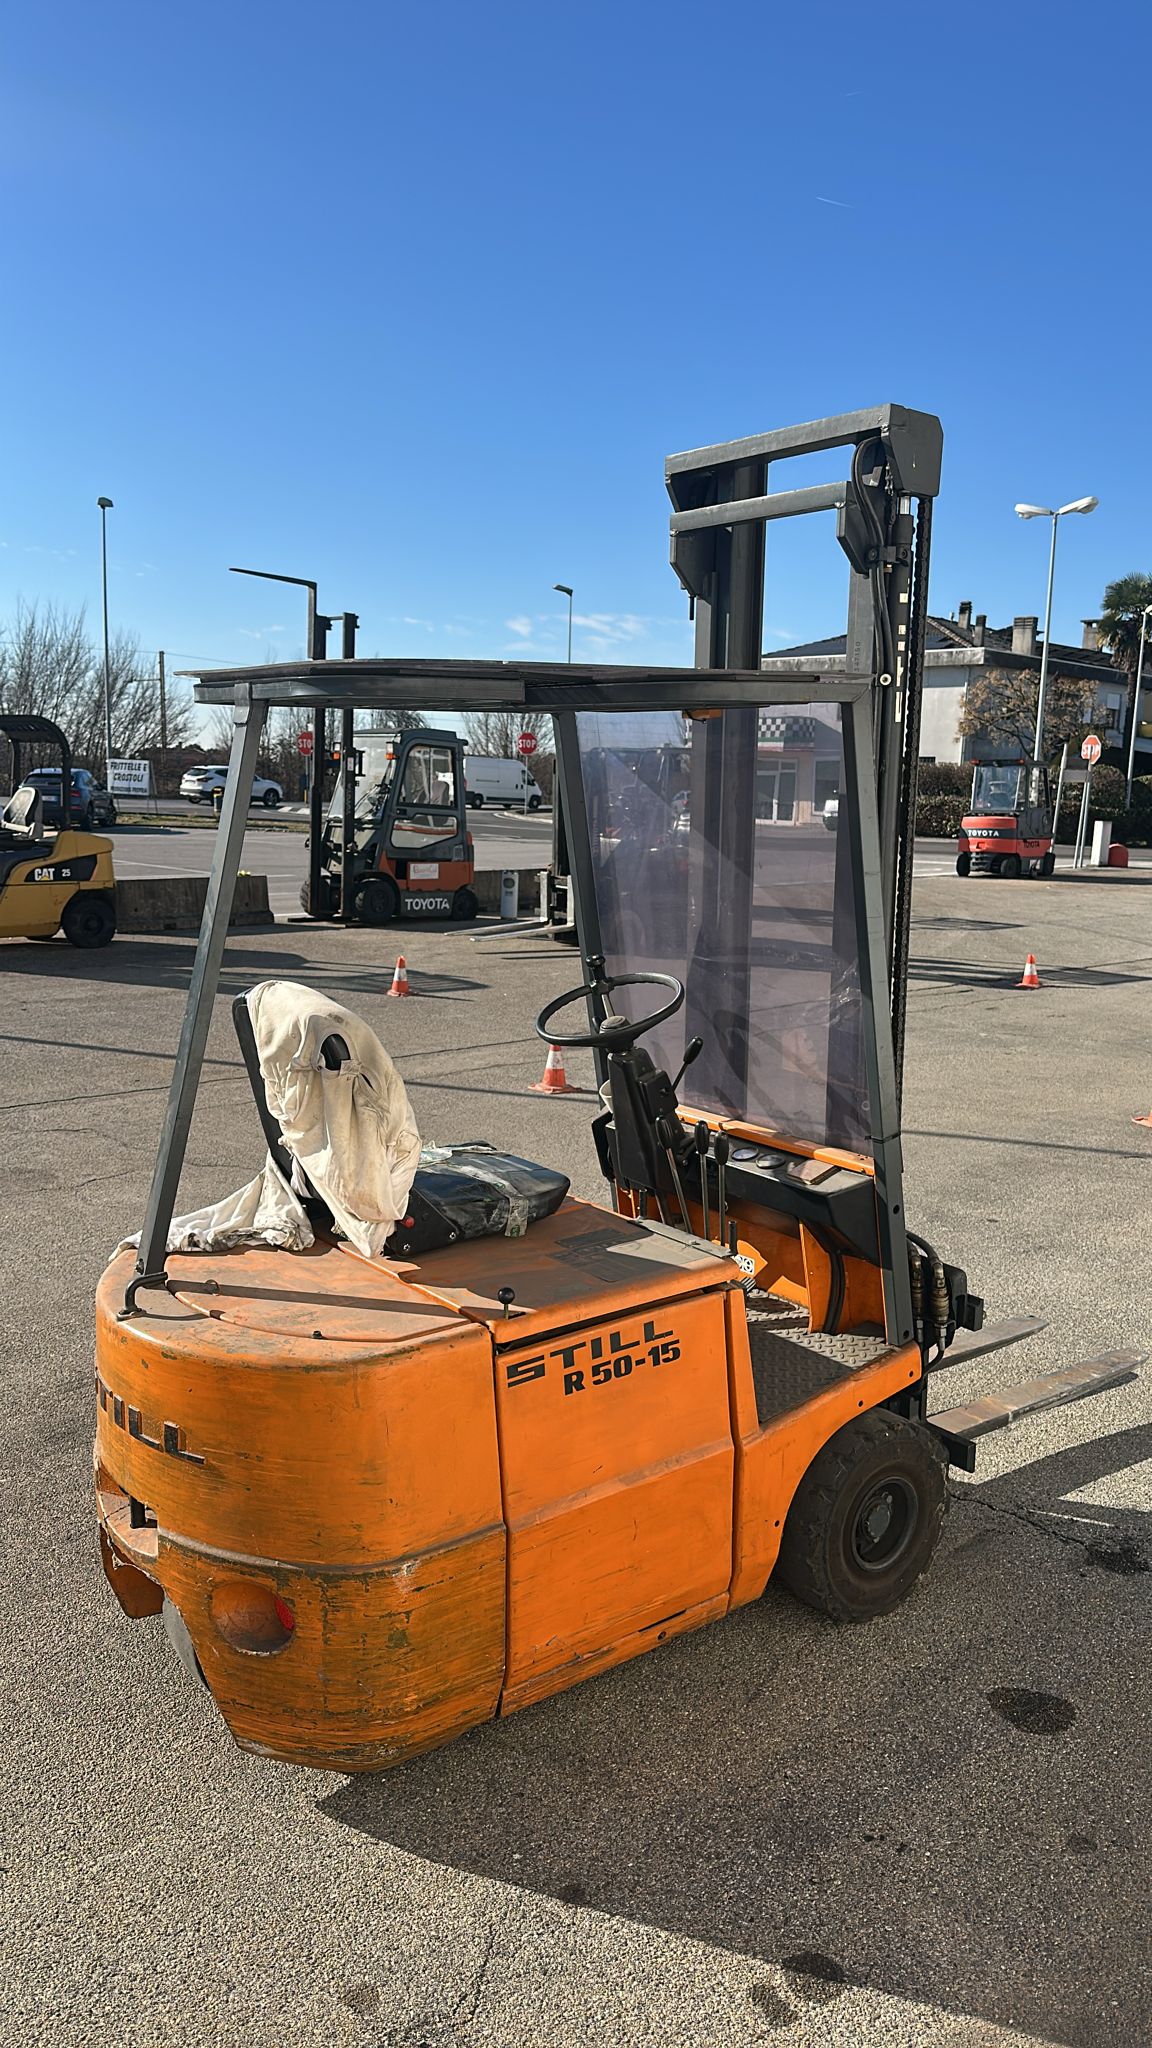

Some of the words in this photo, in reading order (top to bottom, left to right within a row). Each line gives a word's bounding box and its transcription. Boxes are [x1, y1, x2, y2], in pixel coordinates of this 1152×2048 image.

[298, 738, 312, 749] STO
[518, 739, 537, 749] STOP
[110, 761, 142, 771] FRITTELLE
[143, 763, 148, 772] E
[113, 773, 144, 782] CROSTOLI
[968, 829, 1000, 837] TOYOTA
[34, 867, 55, 881] CAT
[61, 868, 71, 877] 25
[404, 897, 450, 910] TOYOTA
[507, 1320, 674, 1388] STILL
[563, 1370, 586, 1396] R
[591, 1338, 681, 1386] 50-15
[96, 1367, 205, 1464] TILL
